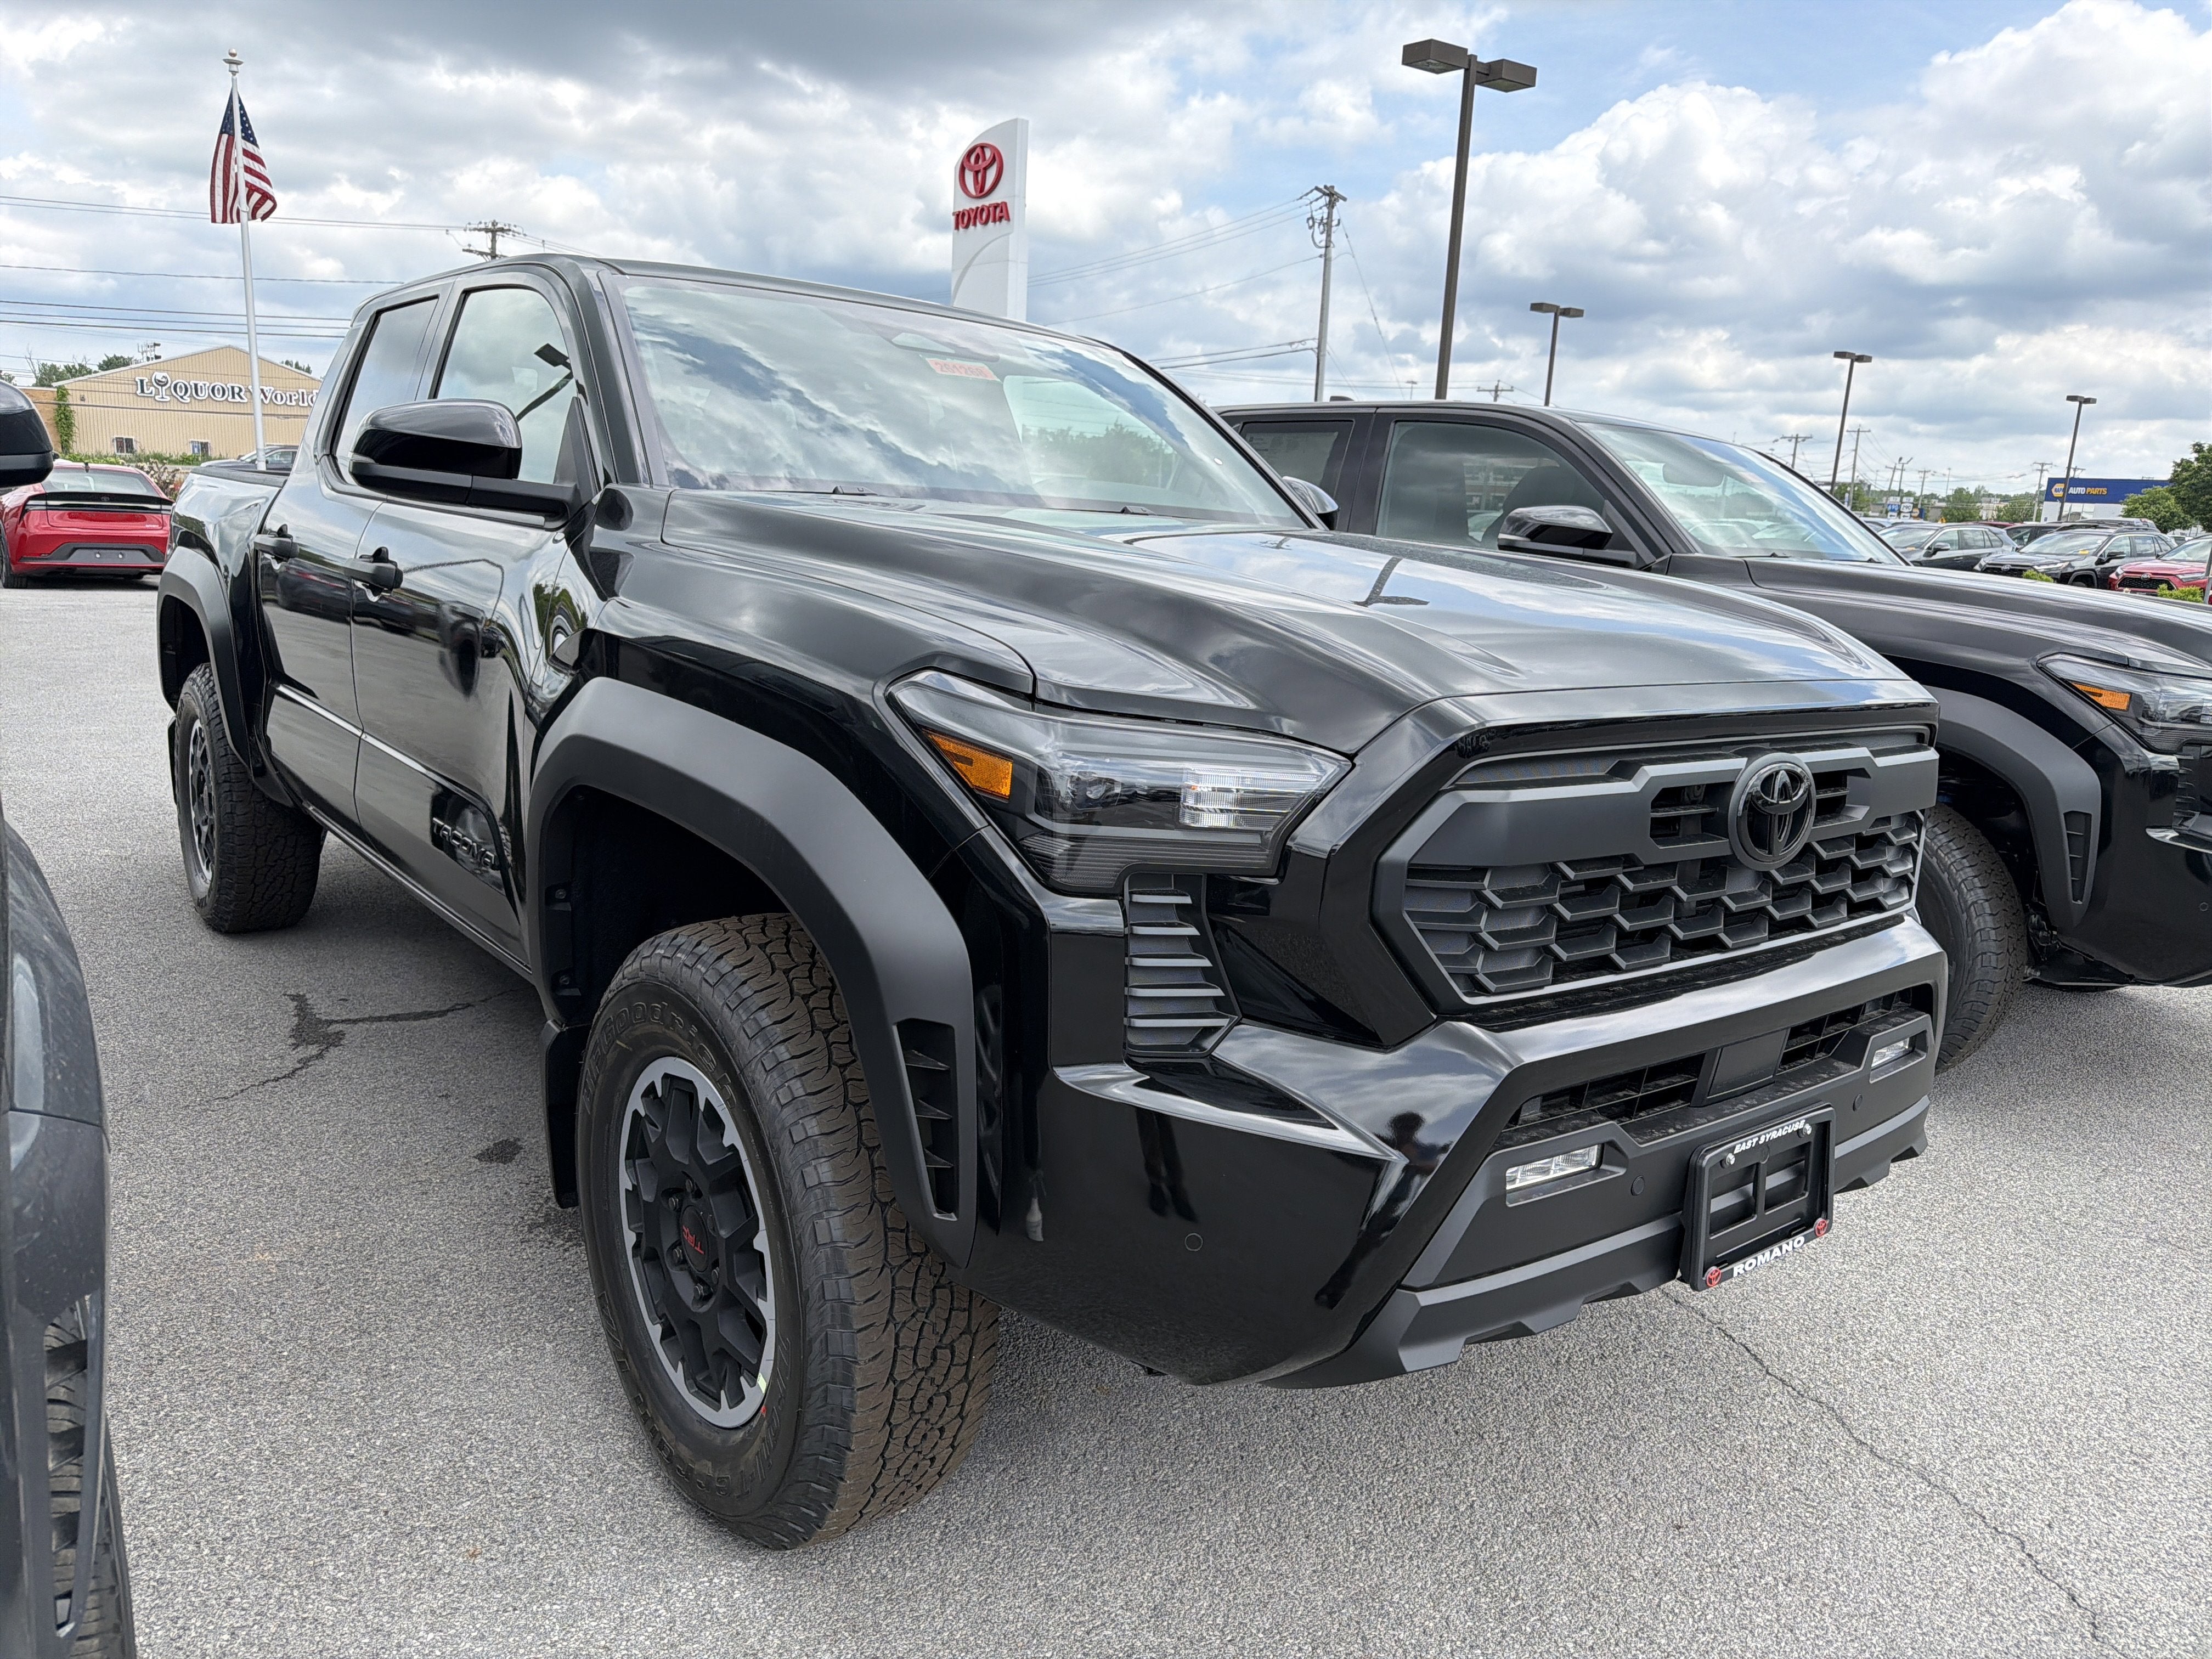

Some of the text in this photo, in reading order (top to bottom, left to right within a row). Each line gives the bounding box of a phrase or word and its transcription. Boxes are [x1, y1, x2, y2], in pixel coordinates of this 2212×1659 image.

[952, 201, 1011, 230] TOYOTA
[1734, 1120, 1806, 1154] EAST SYRACUSE
[1733, 1235, 1805, 1277] ROMANO
